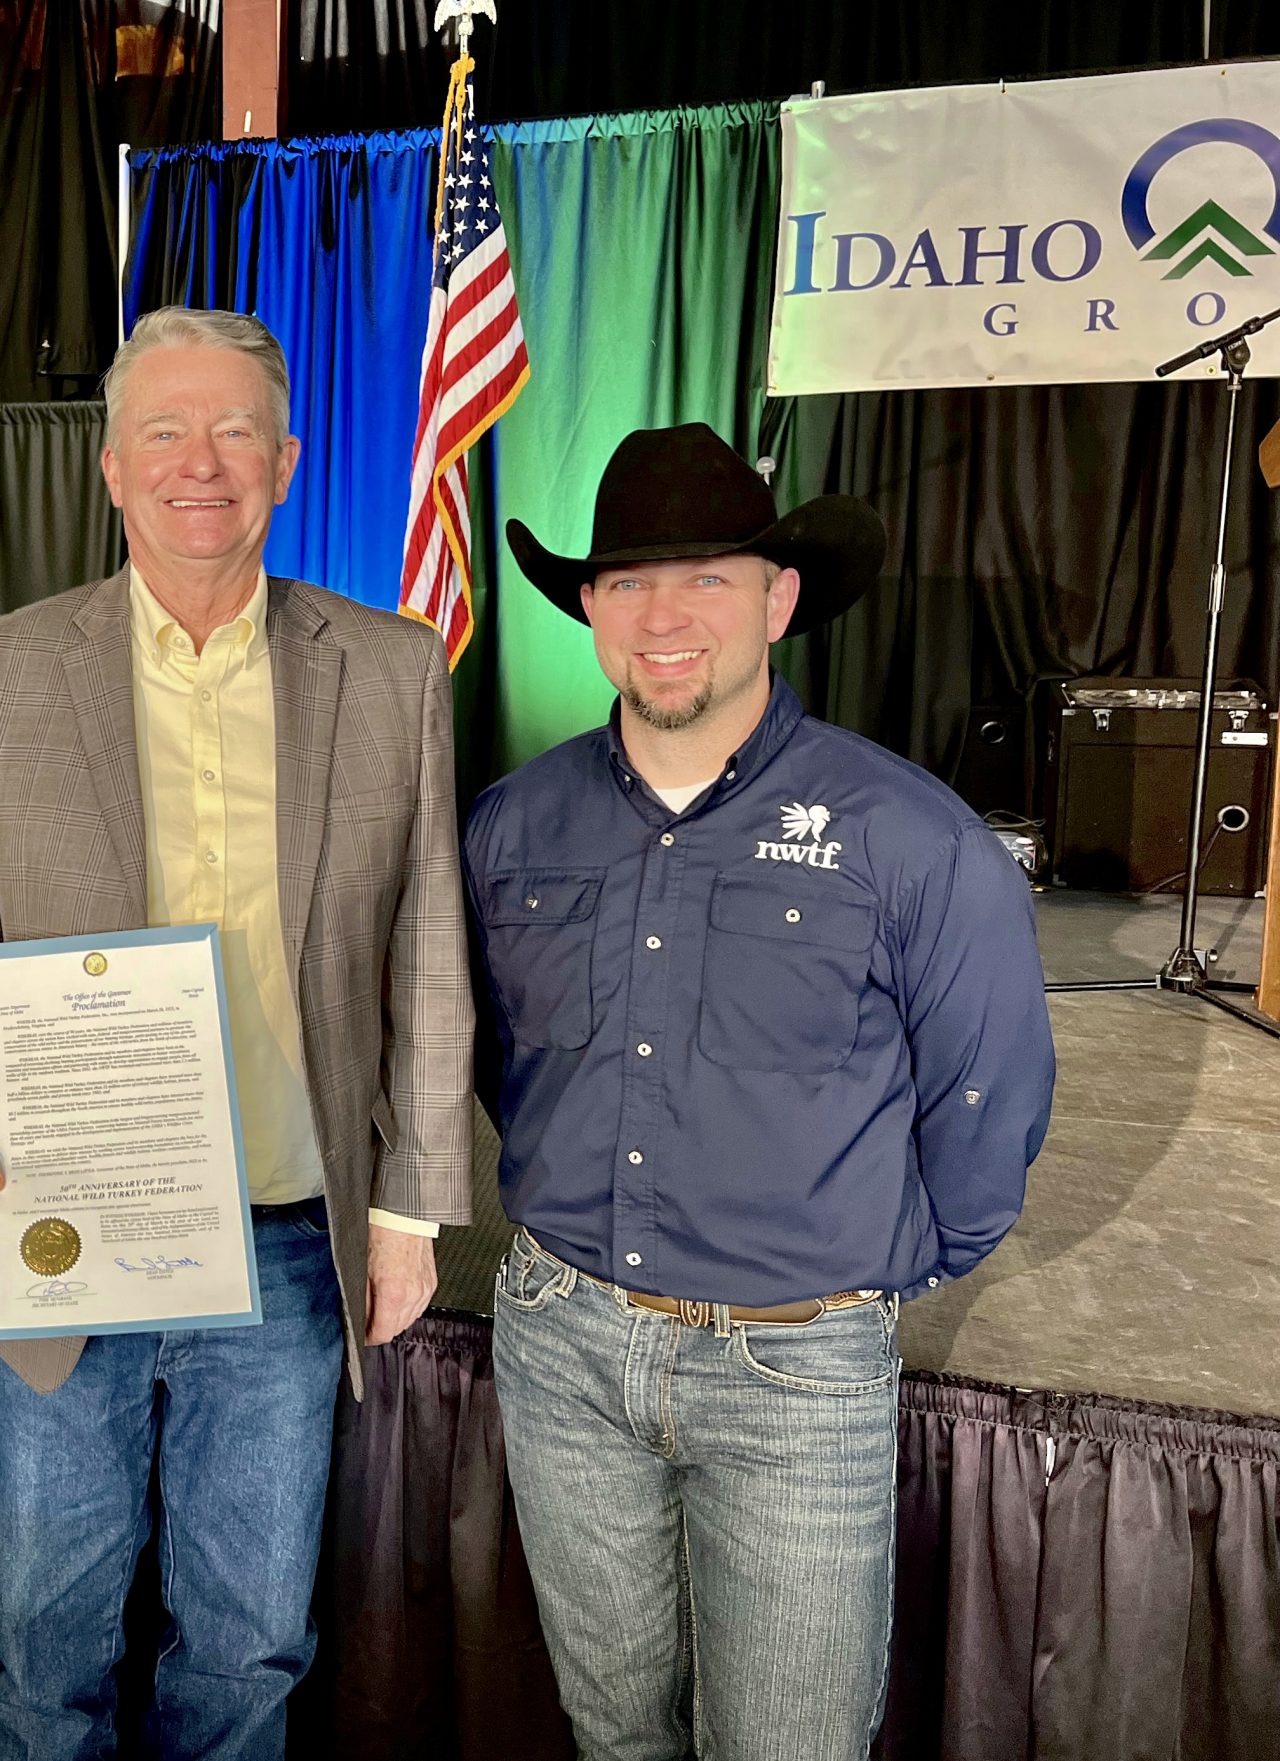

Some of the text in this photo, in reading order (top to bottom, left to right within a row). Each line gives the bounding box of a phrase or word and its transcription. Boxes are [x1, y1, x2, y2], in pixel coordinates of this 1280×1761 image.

[783, 211, 1103, 296] IDAHO
[72, 999, 126, 1011] Proclamation
[74, 993, 90, 1002] Office
[78, 1179, 141, 1192] ANNIVERSARY
[143, 1178, 155, 1187] OF
[157, 1176, 176, 1185] THE
[34, 1184, 203, 1204] NATIONAL WILD TURKEY FEDERATION
